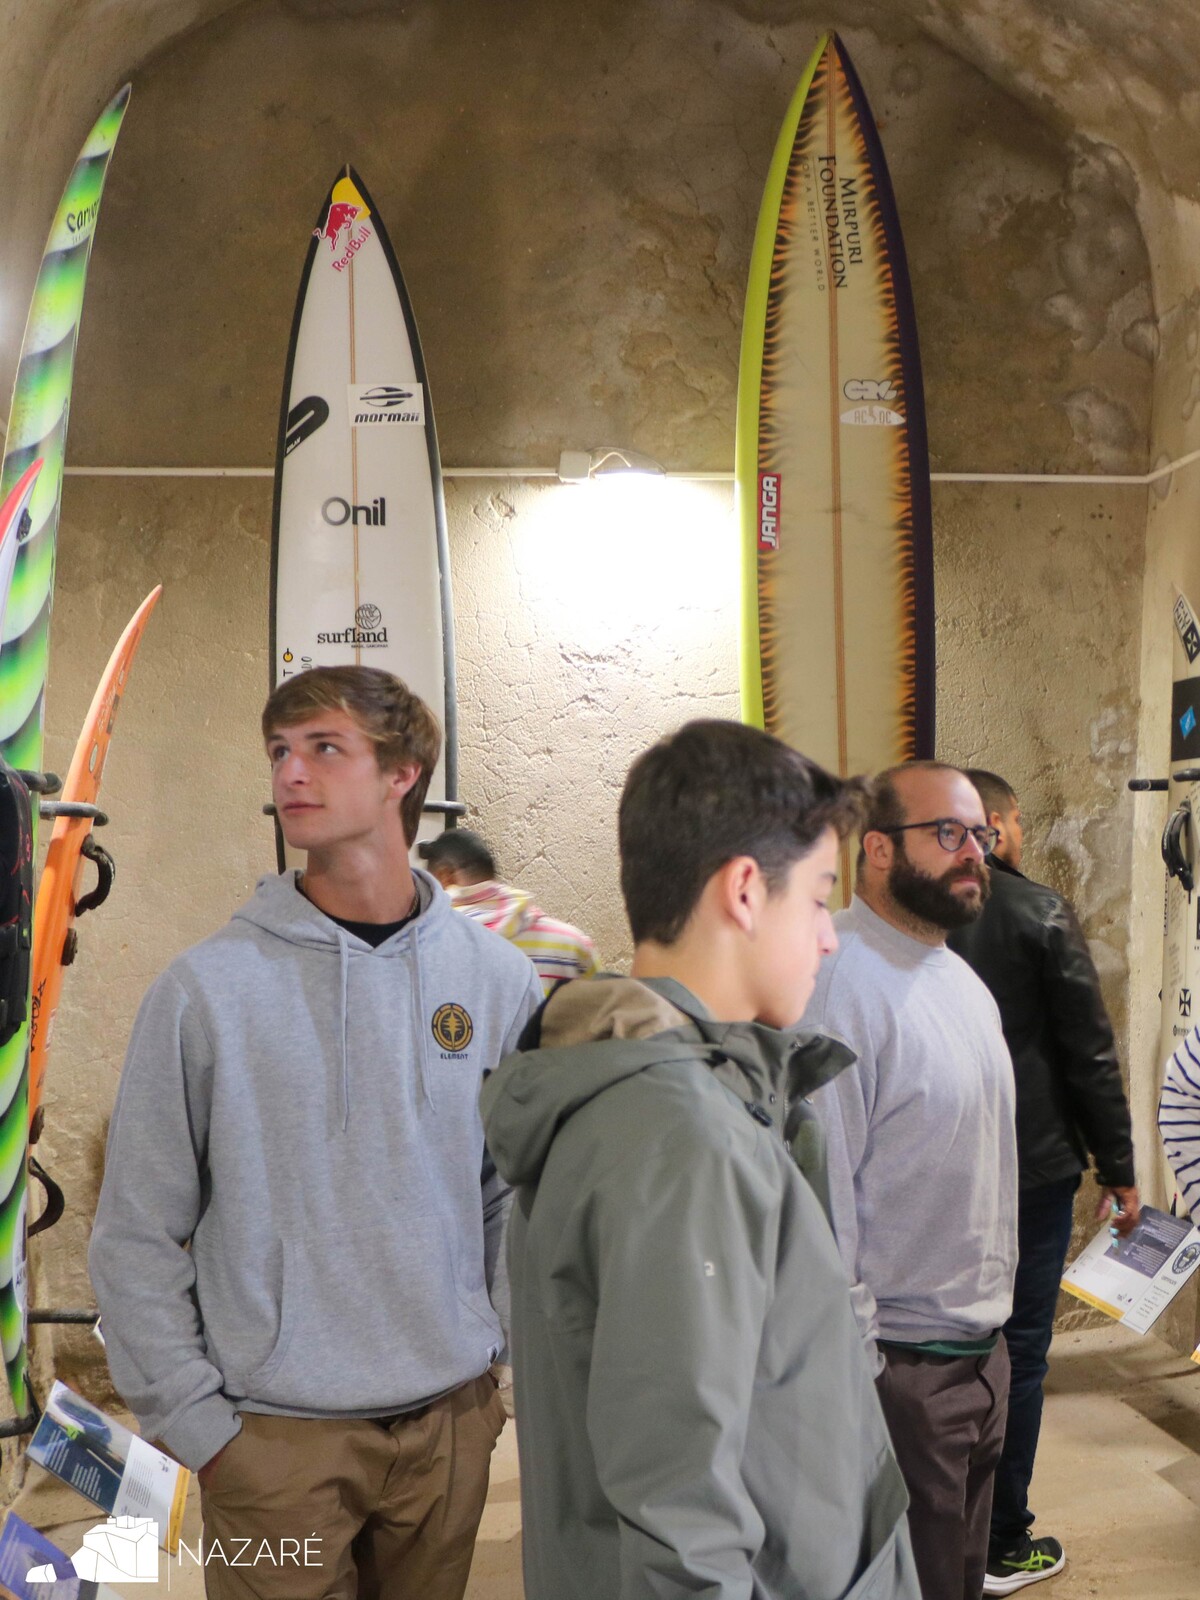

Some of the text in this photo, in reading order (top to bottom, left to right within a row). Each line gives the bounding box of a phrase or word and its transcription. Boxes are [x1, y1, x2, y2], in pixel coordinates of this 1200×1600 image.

[817, 154, 848, 289] FOUNDATION
[838, 176, 863, 266] MIRPURI
[332, 225, 371, 272] Red Bull
[354, 412, 420, 423] mormaii
[321, 496, 386, 526] Onil
[761, 476, 778, 550] JANGA
[317, 627, 388, 644] surfland
